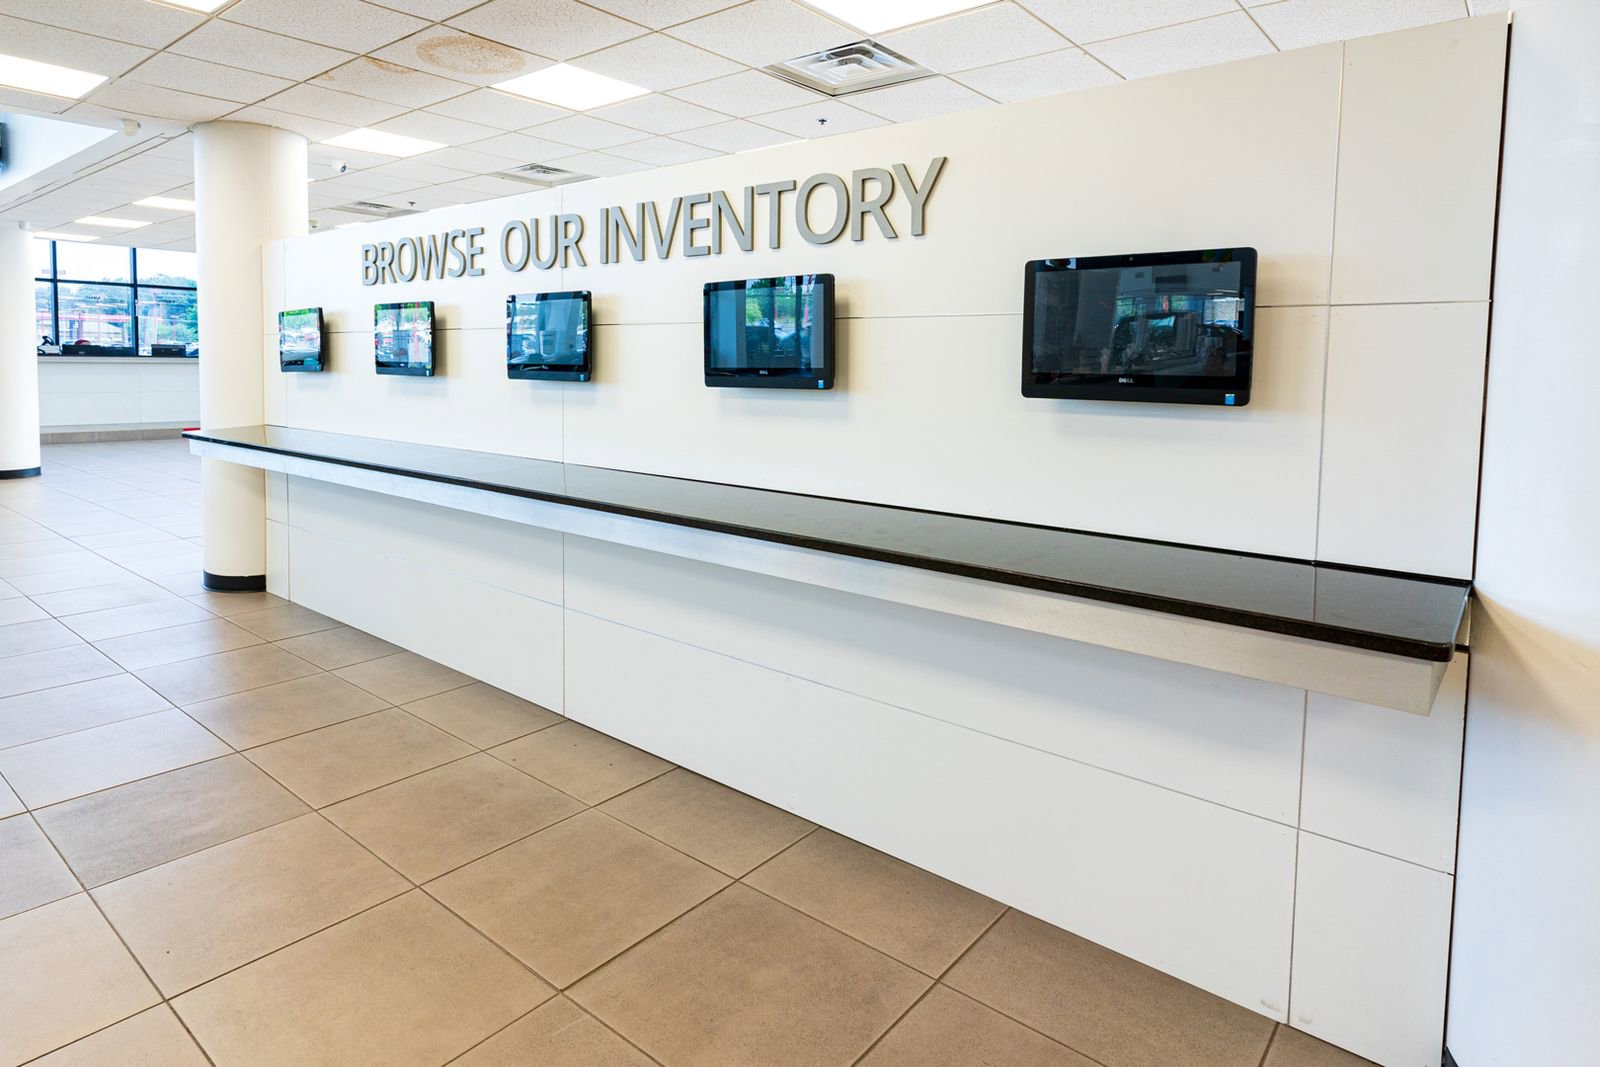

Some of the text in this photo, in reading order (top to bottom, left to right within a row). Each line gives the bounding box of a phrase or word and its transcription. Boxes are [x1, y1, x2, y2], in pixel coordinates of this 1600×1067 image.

[361, 156, 948, 286] BROWSE OUR INVENTORY
